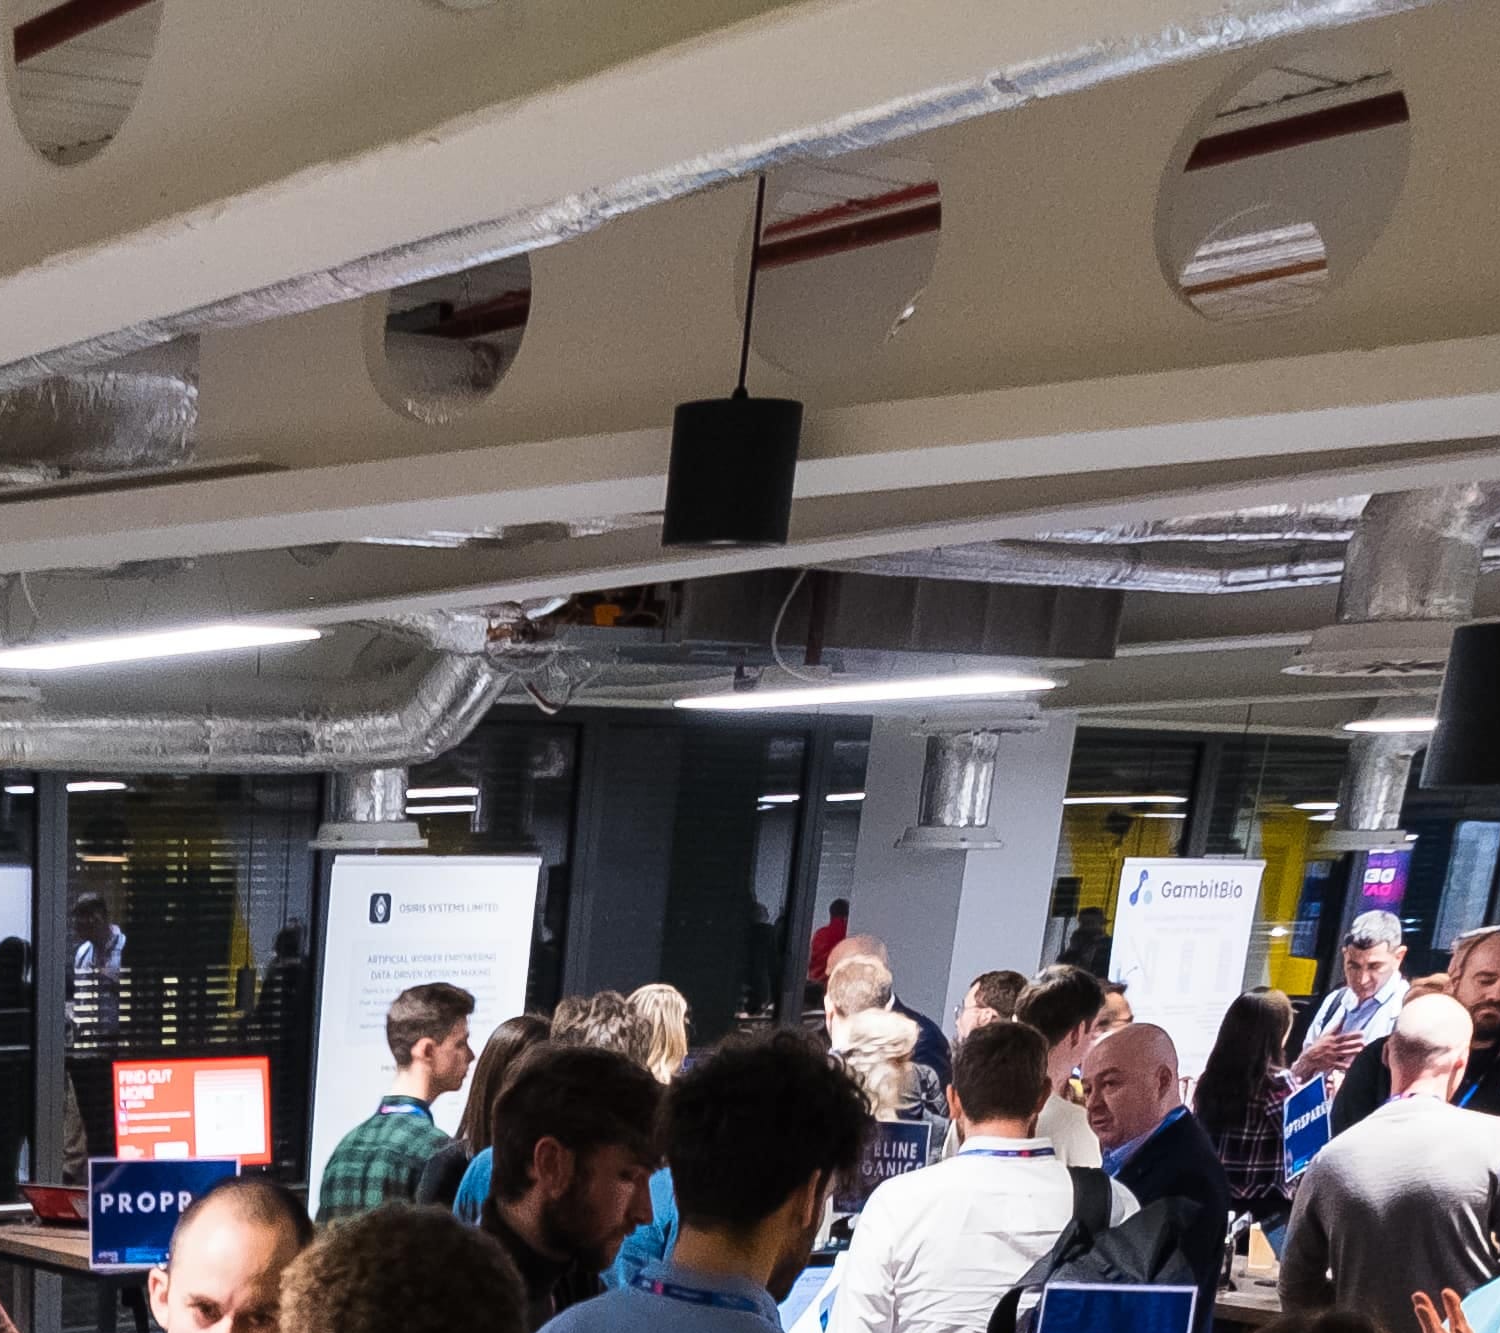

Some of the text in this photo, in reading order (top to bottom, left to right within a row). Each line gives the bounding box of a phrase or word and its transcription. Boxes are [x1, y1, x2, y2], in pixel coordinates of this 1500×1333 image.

[1161, 879, 1243, 899] GambitBio
[399, 903, 427, 914] OSIRIS
[428, 903, 465, 913] SYSTEMS
[118, 1068, 173, 1085] FIND OUT
[874, 1141, 918, 1159] ELINE
